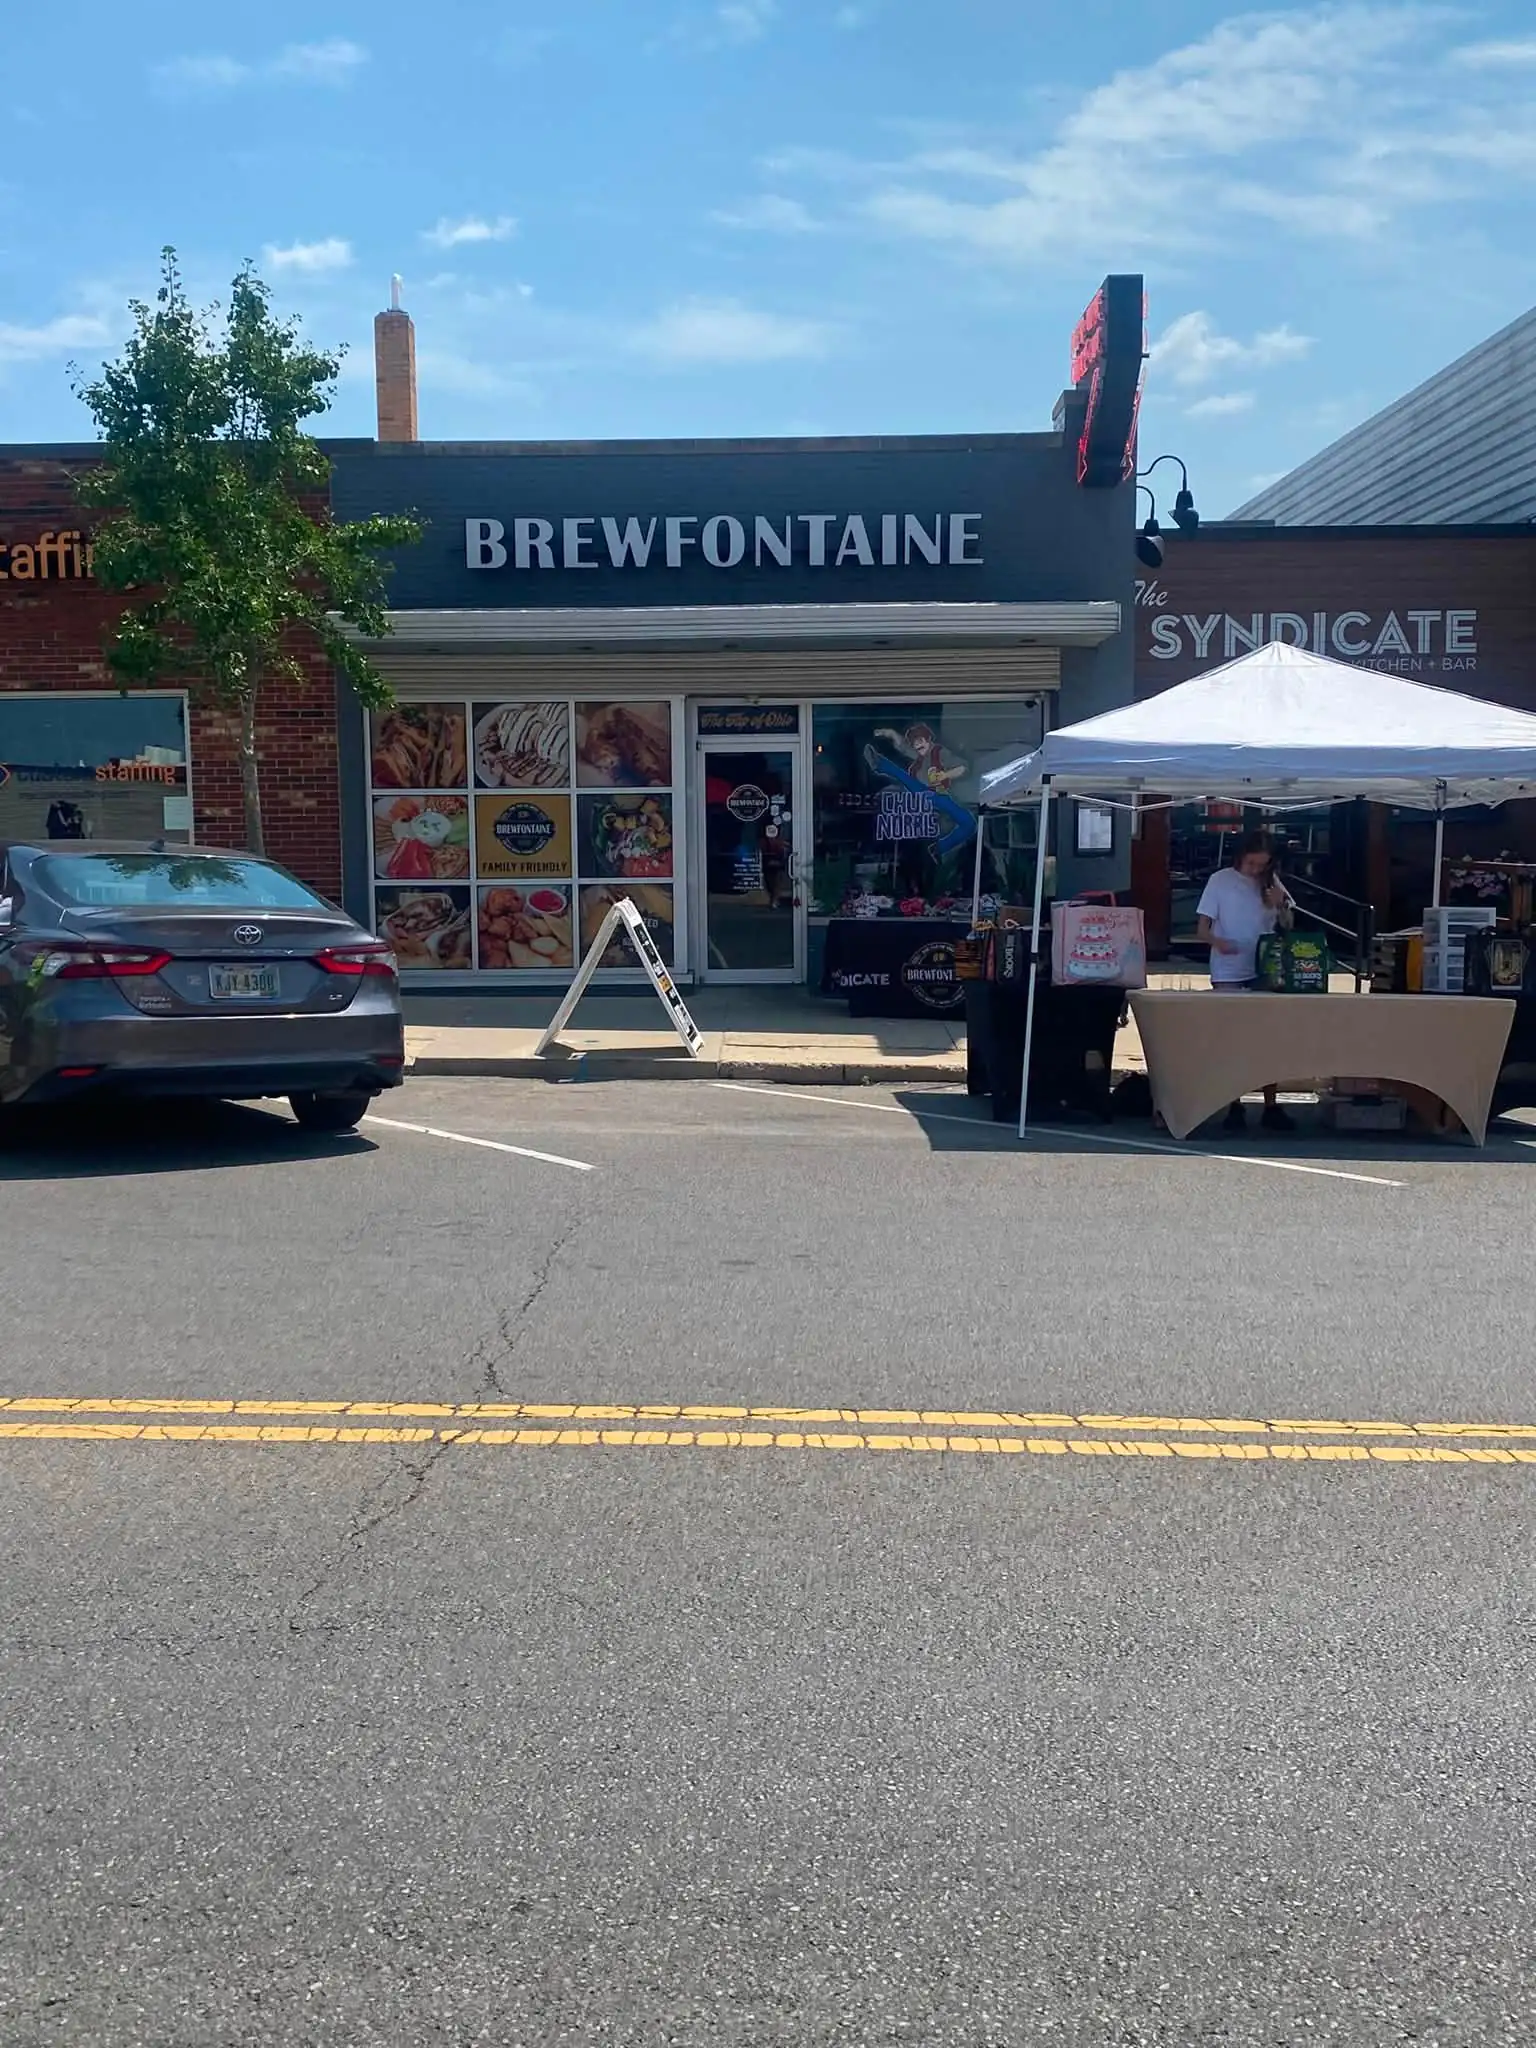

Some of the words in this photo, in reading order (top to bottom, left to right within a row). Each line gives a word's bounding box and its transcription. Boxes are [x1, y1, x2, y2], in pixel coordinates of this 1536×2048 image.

[465, 513, 984, 569] BREWFONTAINE
[1134, 580, 1169, 607] The
[1148, 609, 1477, 660] SYNDICATE
[1442, 657, 1477, 671] BAR
[95, 760, 176, 786] staffing
[496, 823, 552, 834] BREWFONTAINE
[482, 861, 517, 873] FAMILY
[520, 861, 568, 873] FRIENDLY
